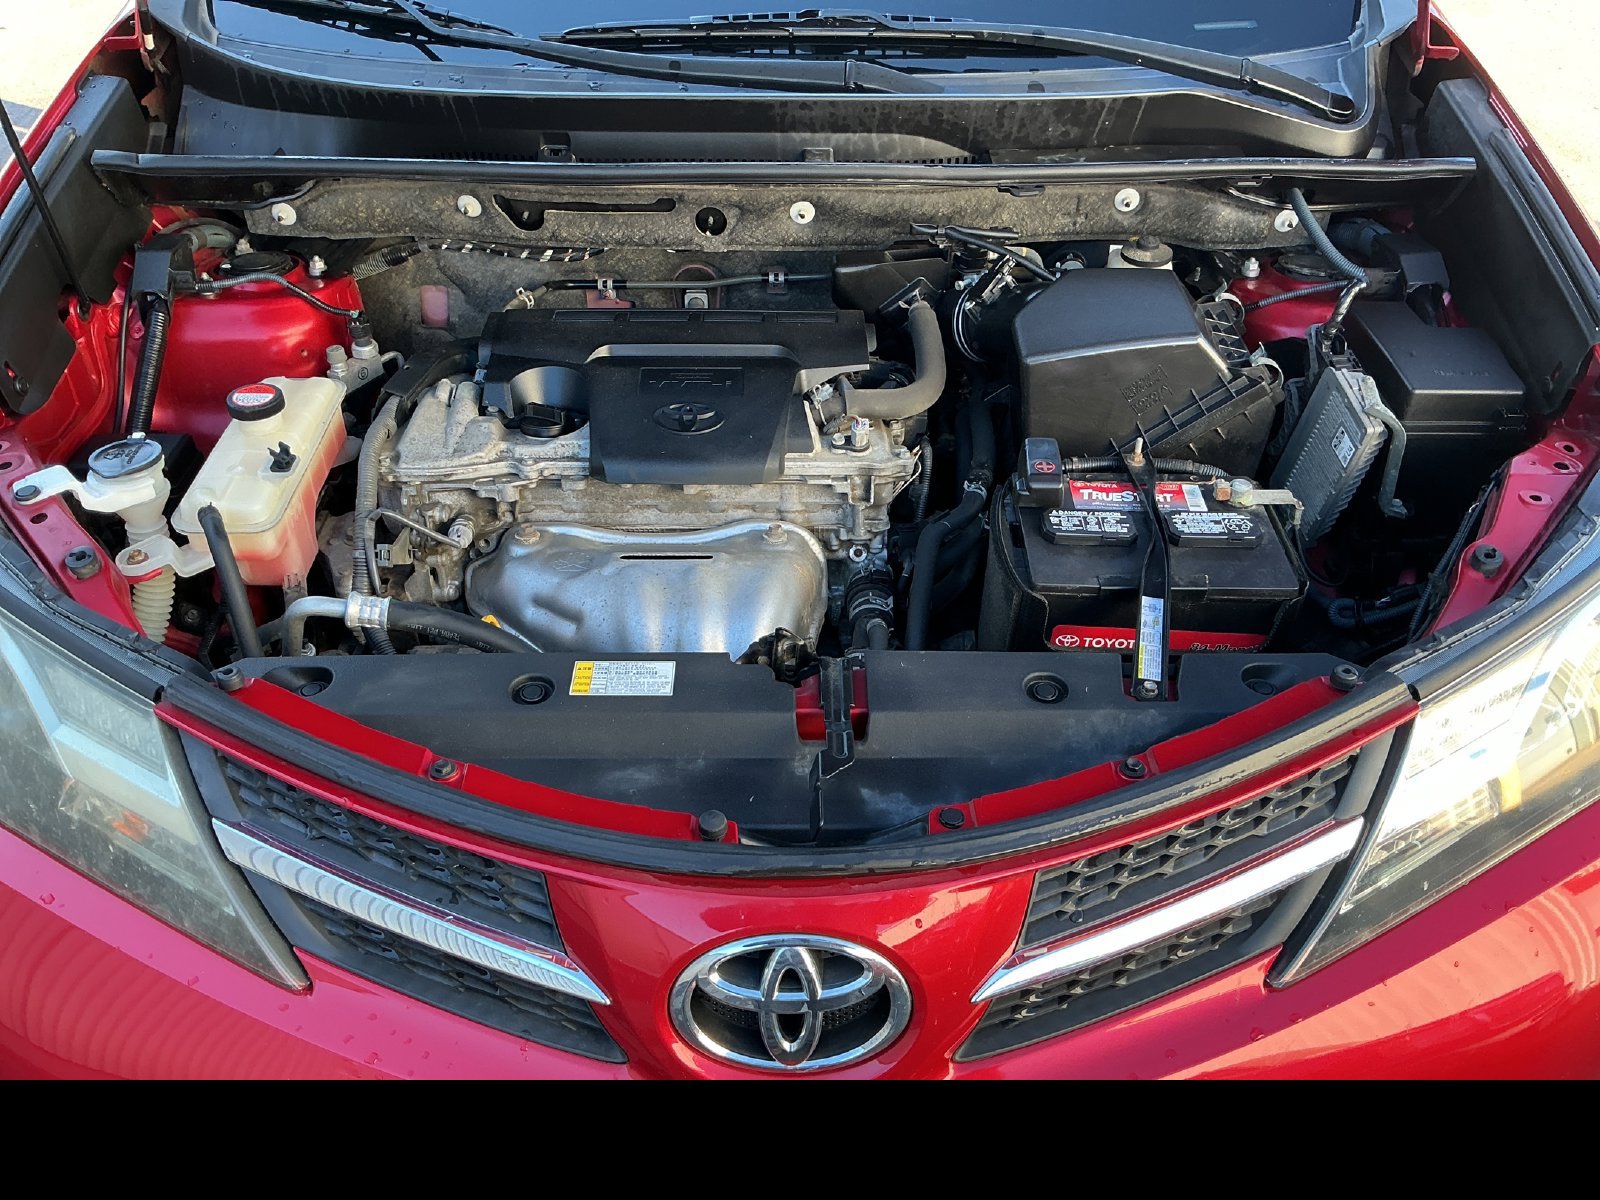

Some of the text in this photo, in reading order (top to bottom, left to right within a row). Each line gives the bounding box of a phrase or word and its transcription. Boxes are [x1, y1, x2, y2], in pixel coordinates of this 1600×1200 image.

[1086, 481, 1118, 489] TOYOTA
[1079, 488, 1174, 503] TRUESTRT
[1083, 637, 1136, 649] TOYOT
